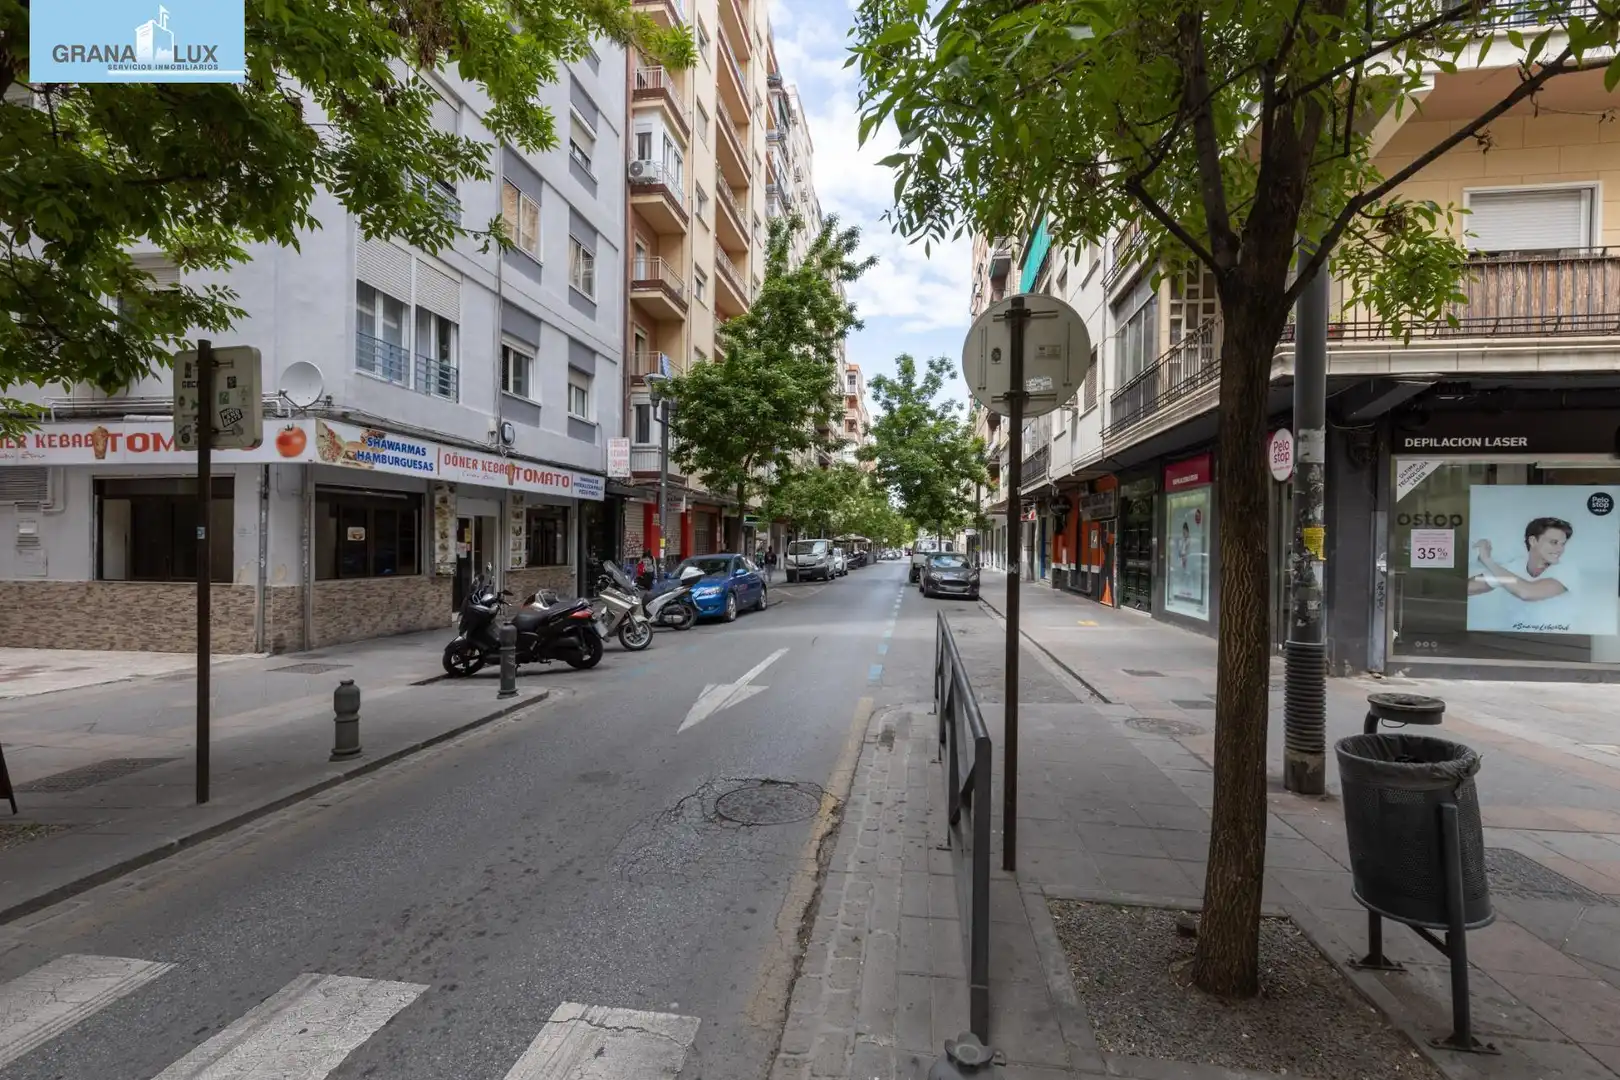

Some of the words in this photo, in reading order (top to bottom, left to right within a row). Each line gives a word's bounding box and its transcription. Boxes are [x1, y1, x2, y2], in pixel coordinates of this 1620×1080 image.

[366, 436, 427, 457] SHAWARMAS
[1273, 440, 1290, 453] Pelo
[1404, 437, 1481, 448] DEPILACION
[1484, 436, 1528, 447] LASER
[355, 449, 434, 472] HAMBURGUESAS
[1273, 451, 1291, 463] stop
[444, 452, 478, 470] DÖNER
[513, 466, 570, 488] TOMATO
